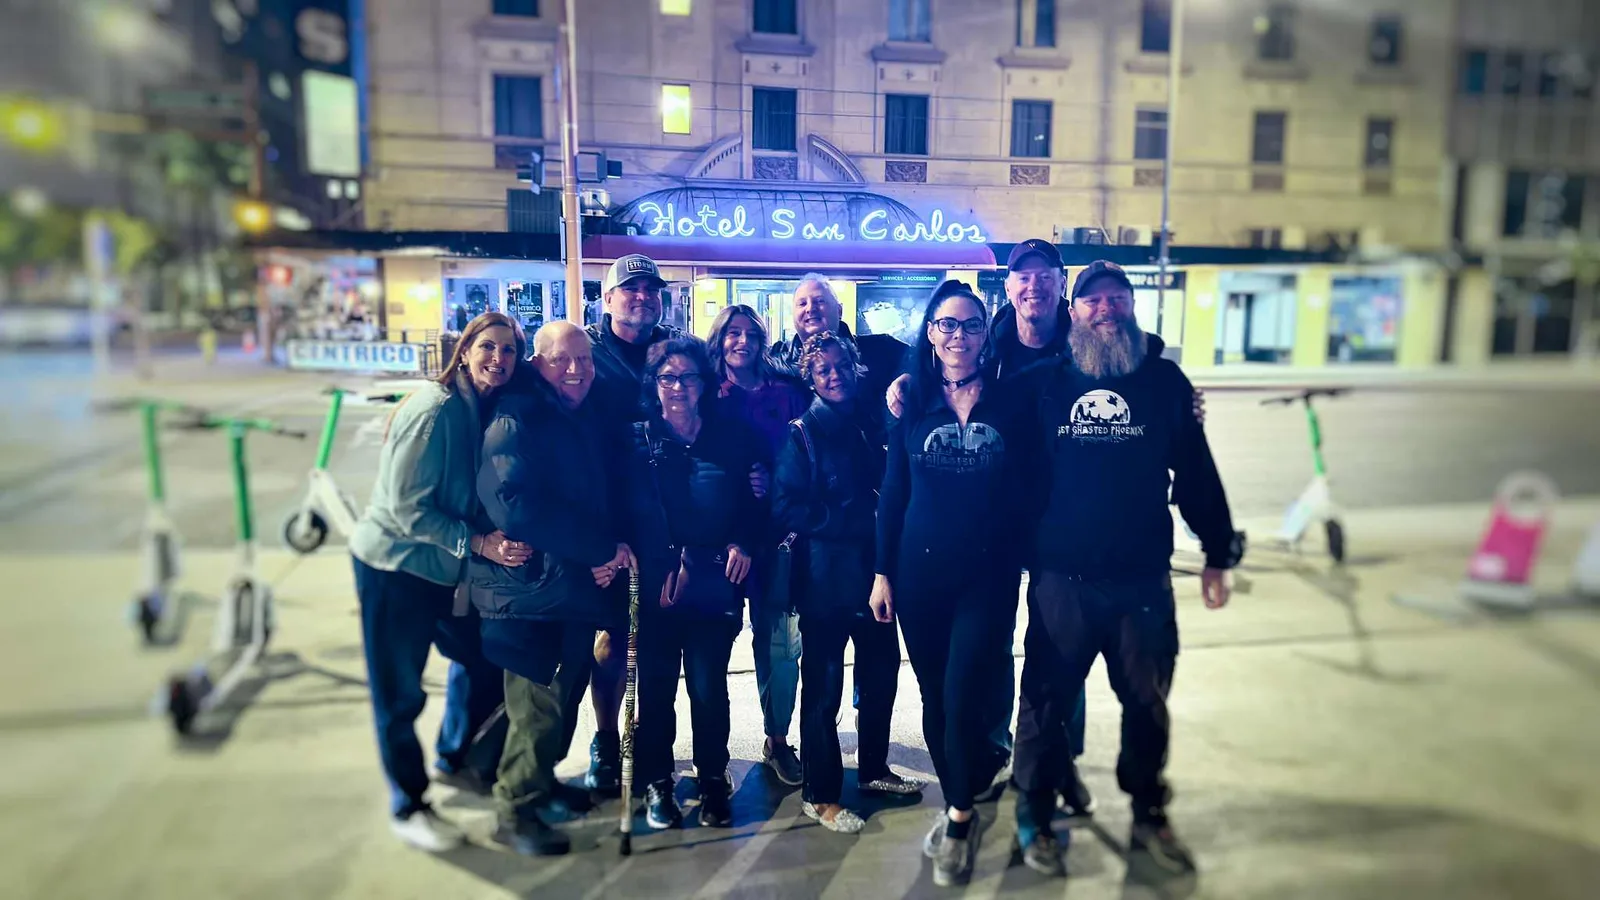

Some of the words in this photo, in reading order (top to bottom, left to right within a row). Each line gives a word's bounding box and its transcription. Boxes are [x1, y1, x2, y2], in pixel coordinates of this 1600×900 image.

[638, 201, 755, 238] Hotel
[772, 208, 845, 240] San
[860, 209, 986, 242] Carlos
[295, 343, 415, 363] CENTRICO
